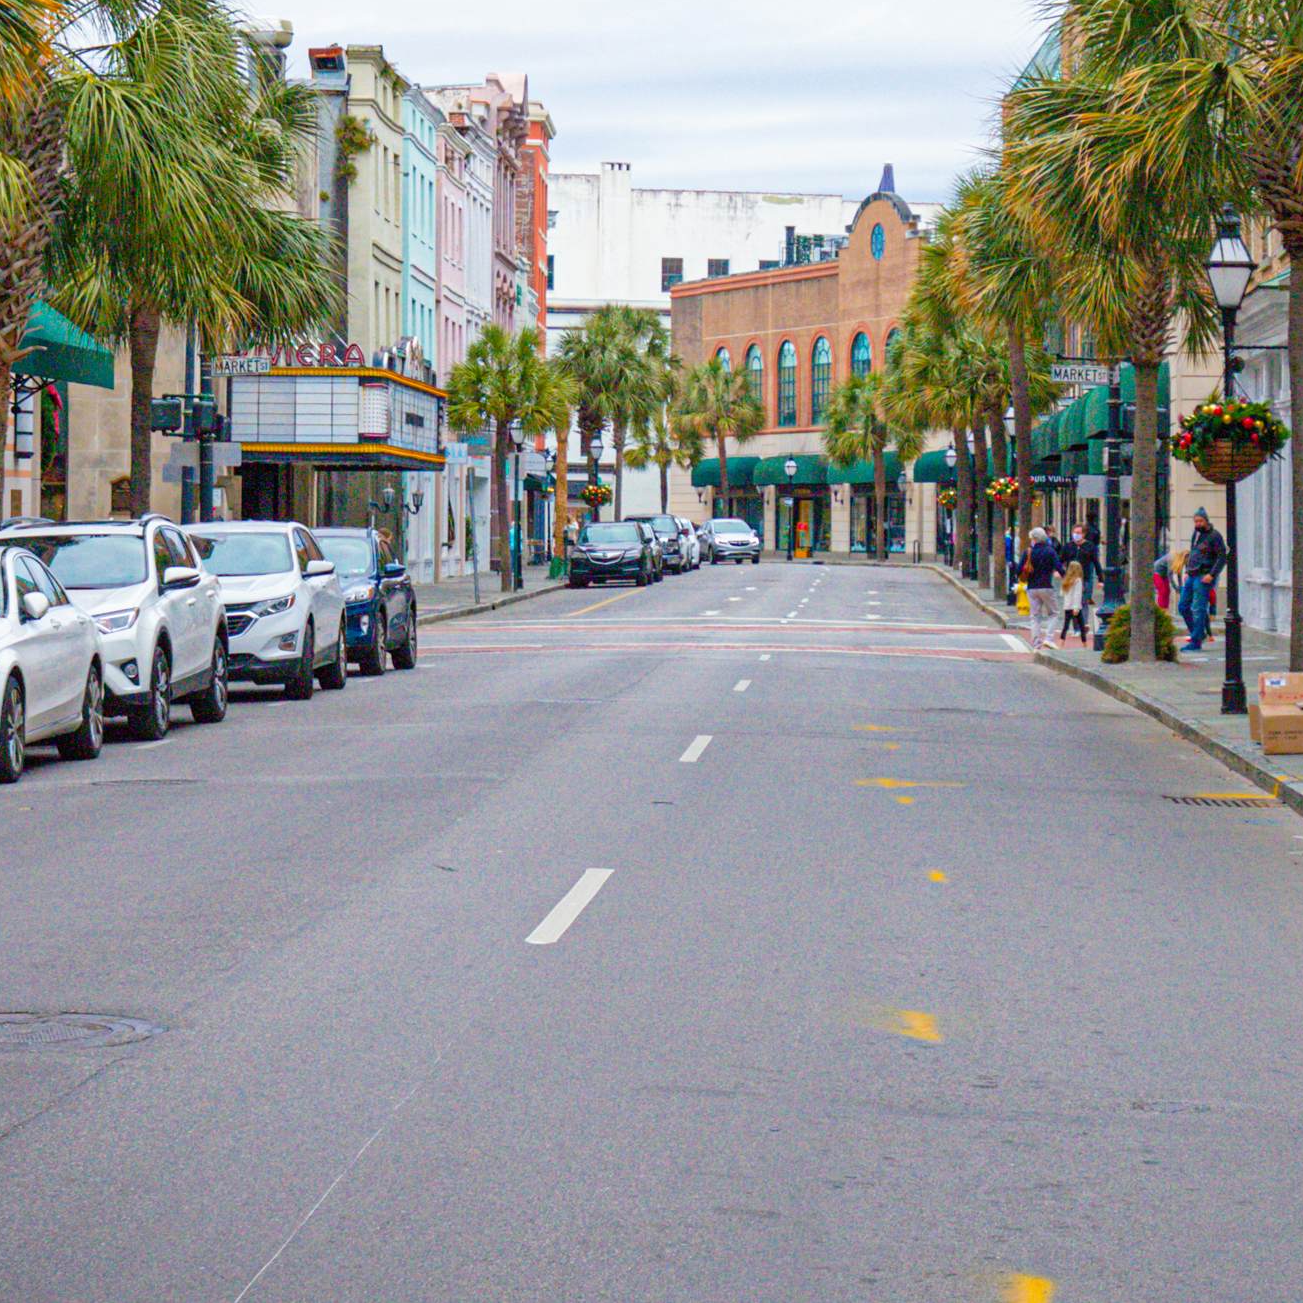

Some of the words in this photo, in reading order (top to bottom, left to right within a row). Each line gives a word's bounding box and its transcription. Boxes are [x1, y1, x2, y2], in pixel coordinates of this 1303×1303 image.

[214, 359, 259, 374] MARKET
[1053, 367, 1097, 382] MARKET
[1098, 371, 1107, 380] ST
